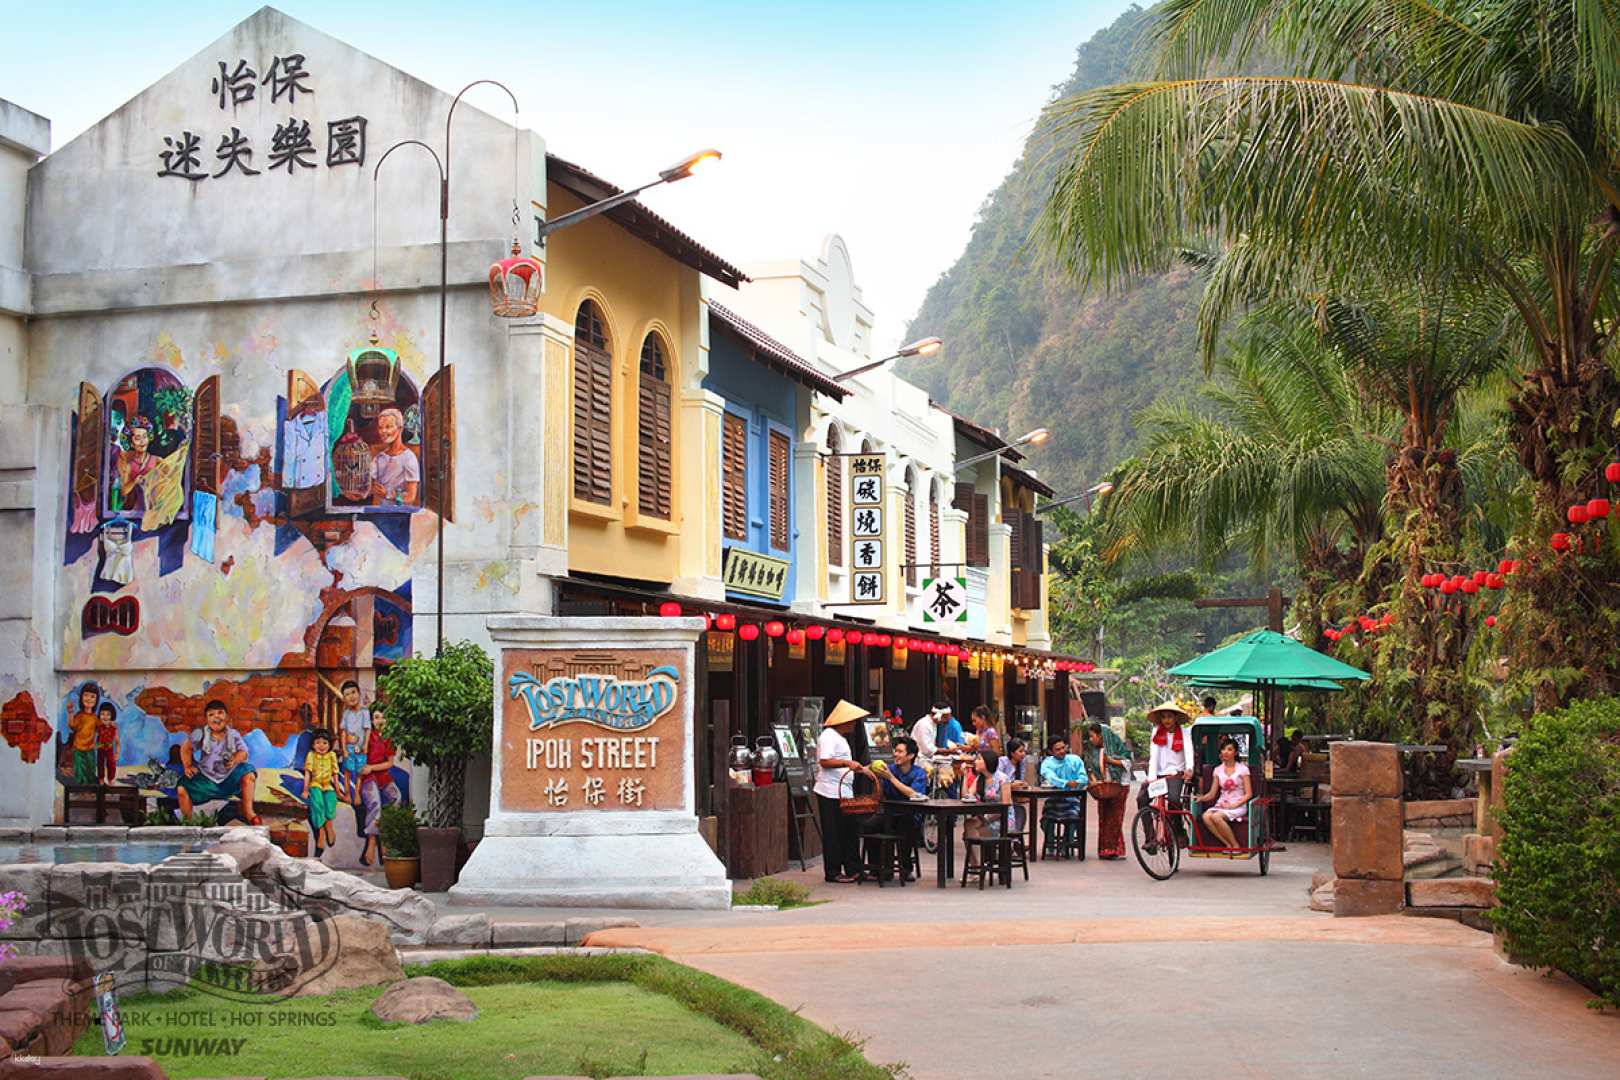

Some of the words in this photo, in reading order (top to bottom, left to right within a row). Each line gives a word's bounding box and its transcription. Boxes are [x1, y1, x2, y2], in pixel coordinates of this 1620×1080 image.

[211, 53, 315, 110] 怡保
[157, 115, 368, 181] 迷失樂園
[852, 458, 882, 473] 怡保
[930, 581, 961, 618] 茶
[526, 738, 572, 769] IPOH
[581, 736, 660, 769] STREET
[543, 775, 646, 807] 怡保街
